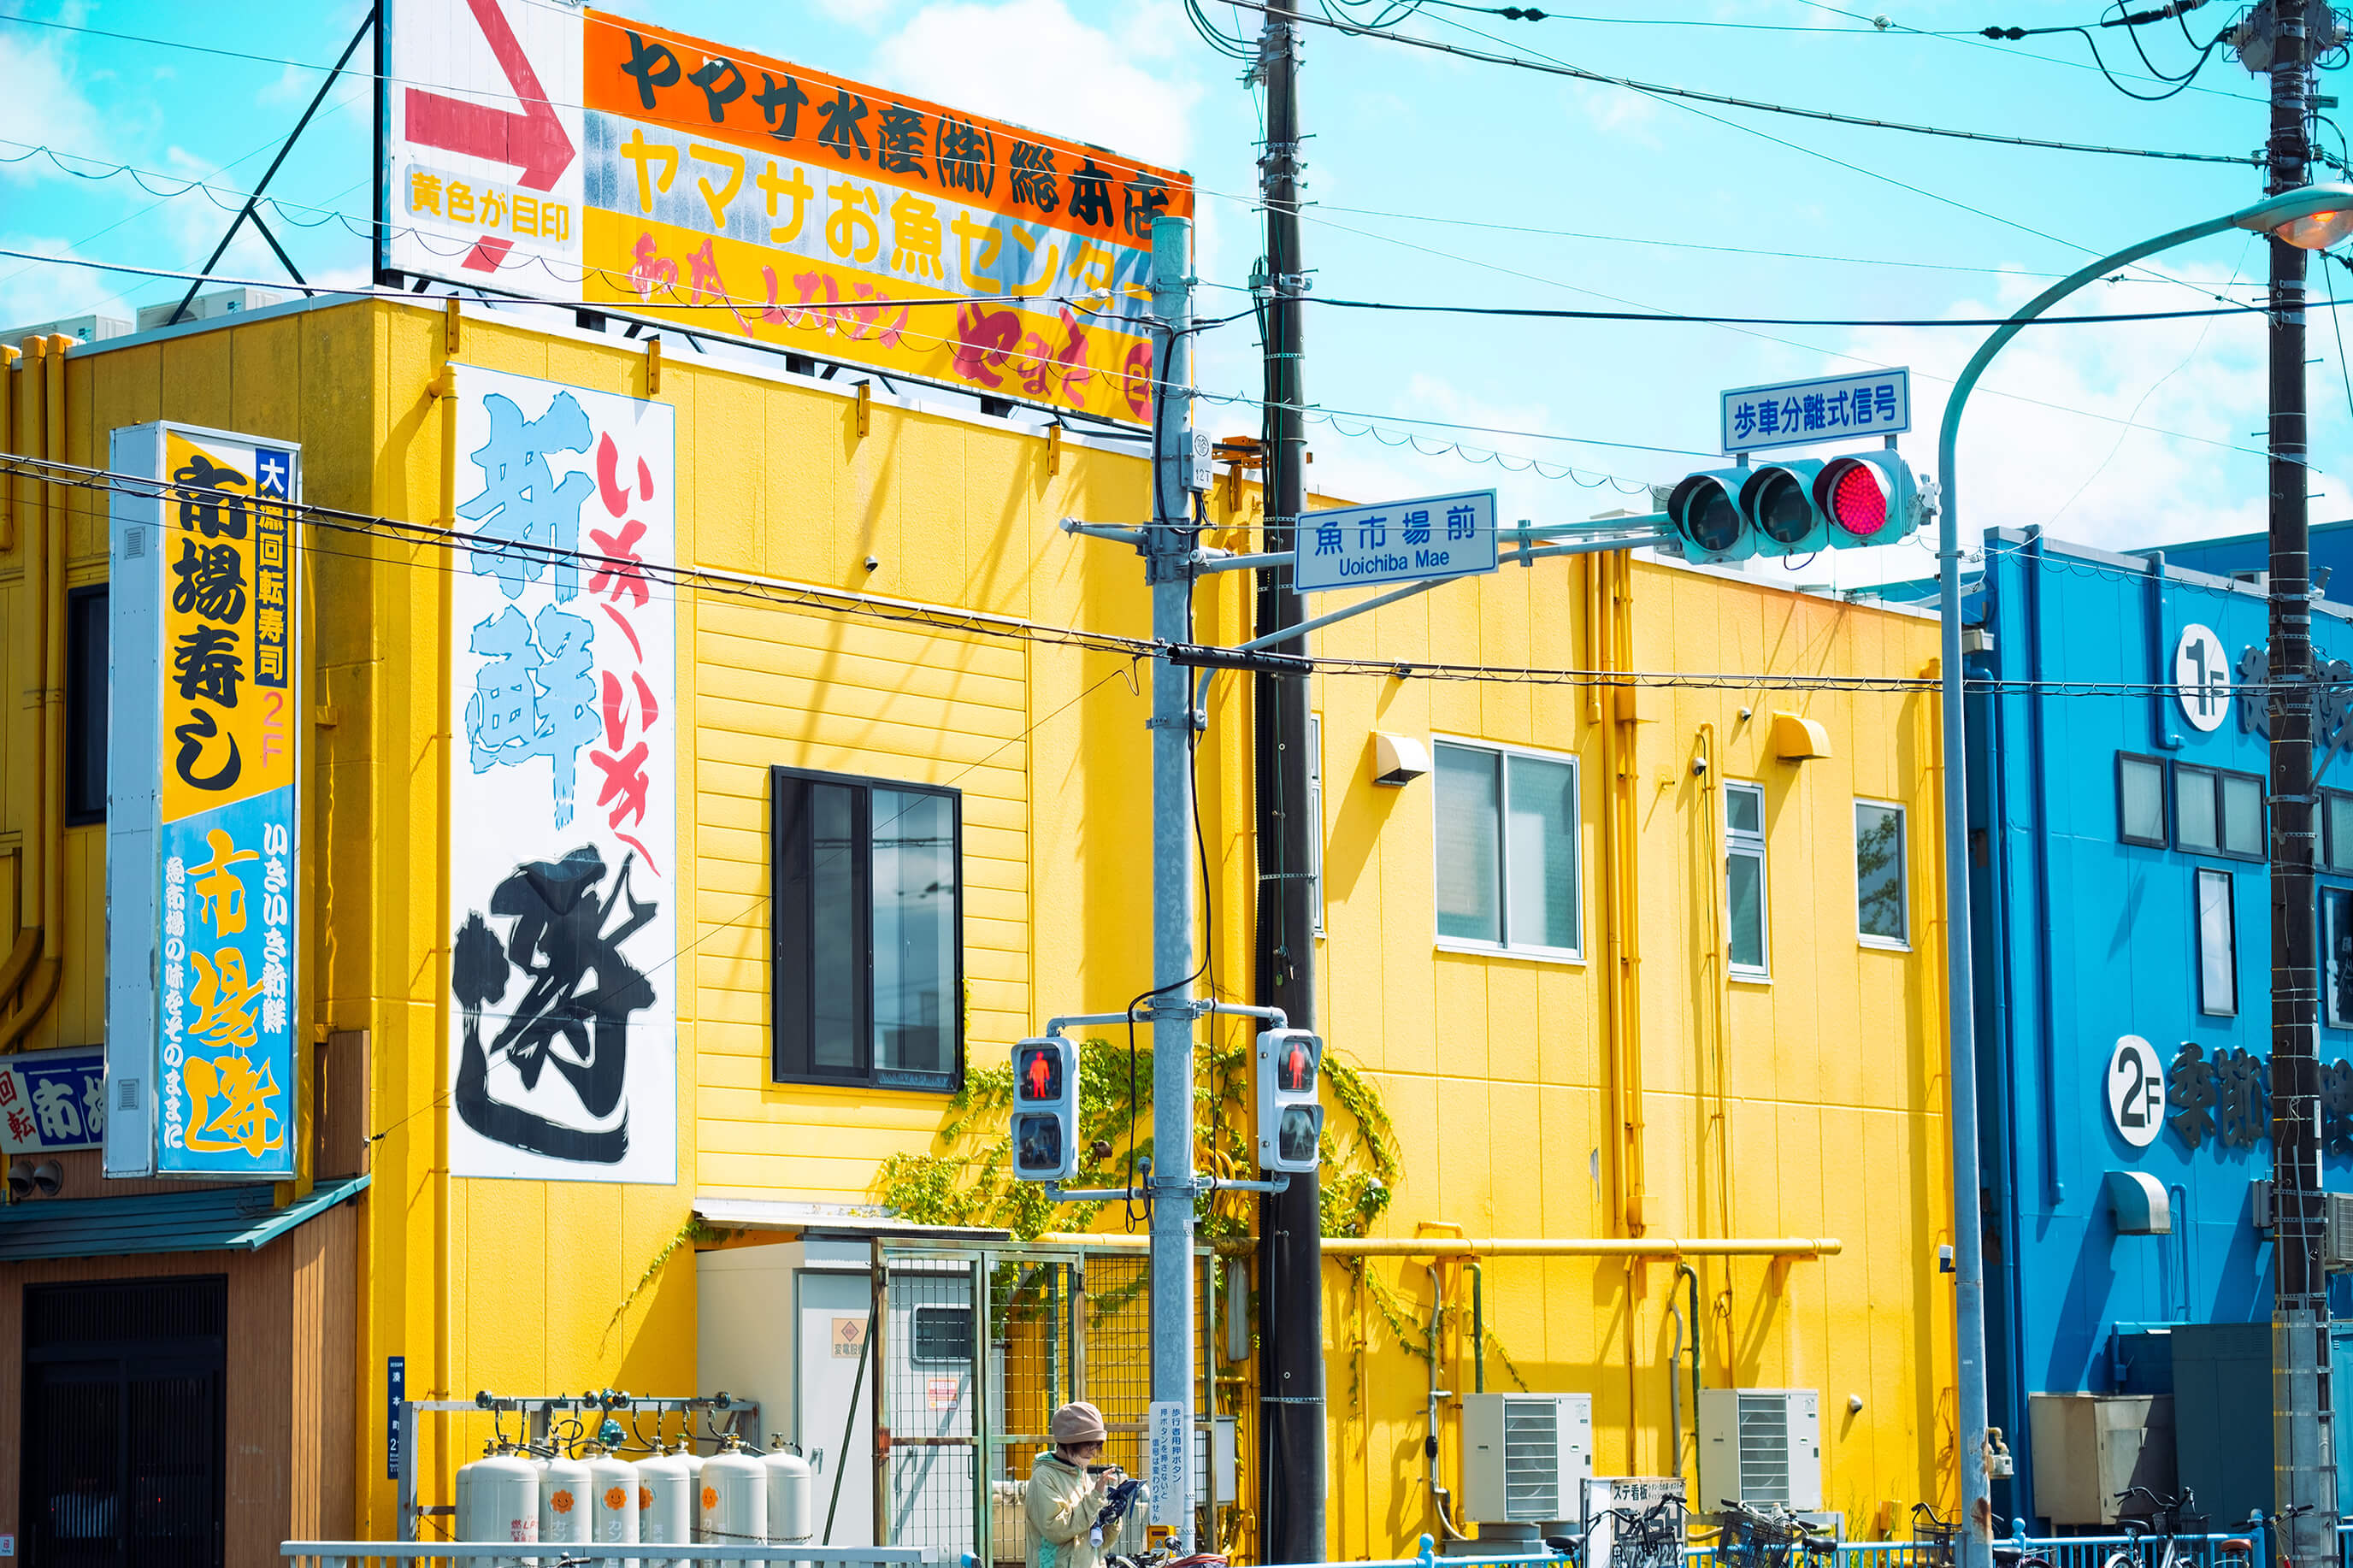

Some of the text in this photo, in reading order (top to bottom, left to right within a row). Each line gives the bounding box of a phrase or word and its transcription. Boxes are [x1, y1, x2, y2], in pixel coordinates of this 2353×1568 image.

[411, 172, 569, 243] 黄色が目印
[1734, 384, 1897, 439] 歩車分離式信号
[258, 457, 286, 682] 大漁回転寿司
[1315, 504, 1476, 557] 魚市場前
[1339, 548, 1450, 577] Uoichiba Mae
[173, 454, 248, 791] 市場寿し
[455, 390, 604, 830] 新鮮
[2185, 638, 2225, 716] 1F
[262, 690, 284, 768] 2F
[262, 822, 288, 1035] いきいき新鮮
[2118, 1046, 2161, 1129] 2F
[1160, 1408, 1169, 1500] 押ボタンを押さないと
[1171, 1408, 1182, 1483] 歩行者用押ボタン
[1613, 1483, 1648, 1501] ステ看板
